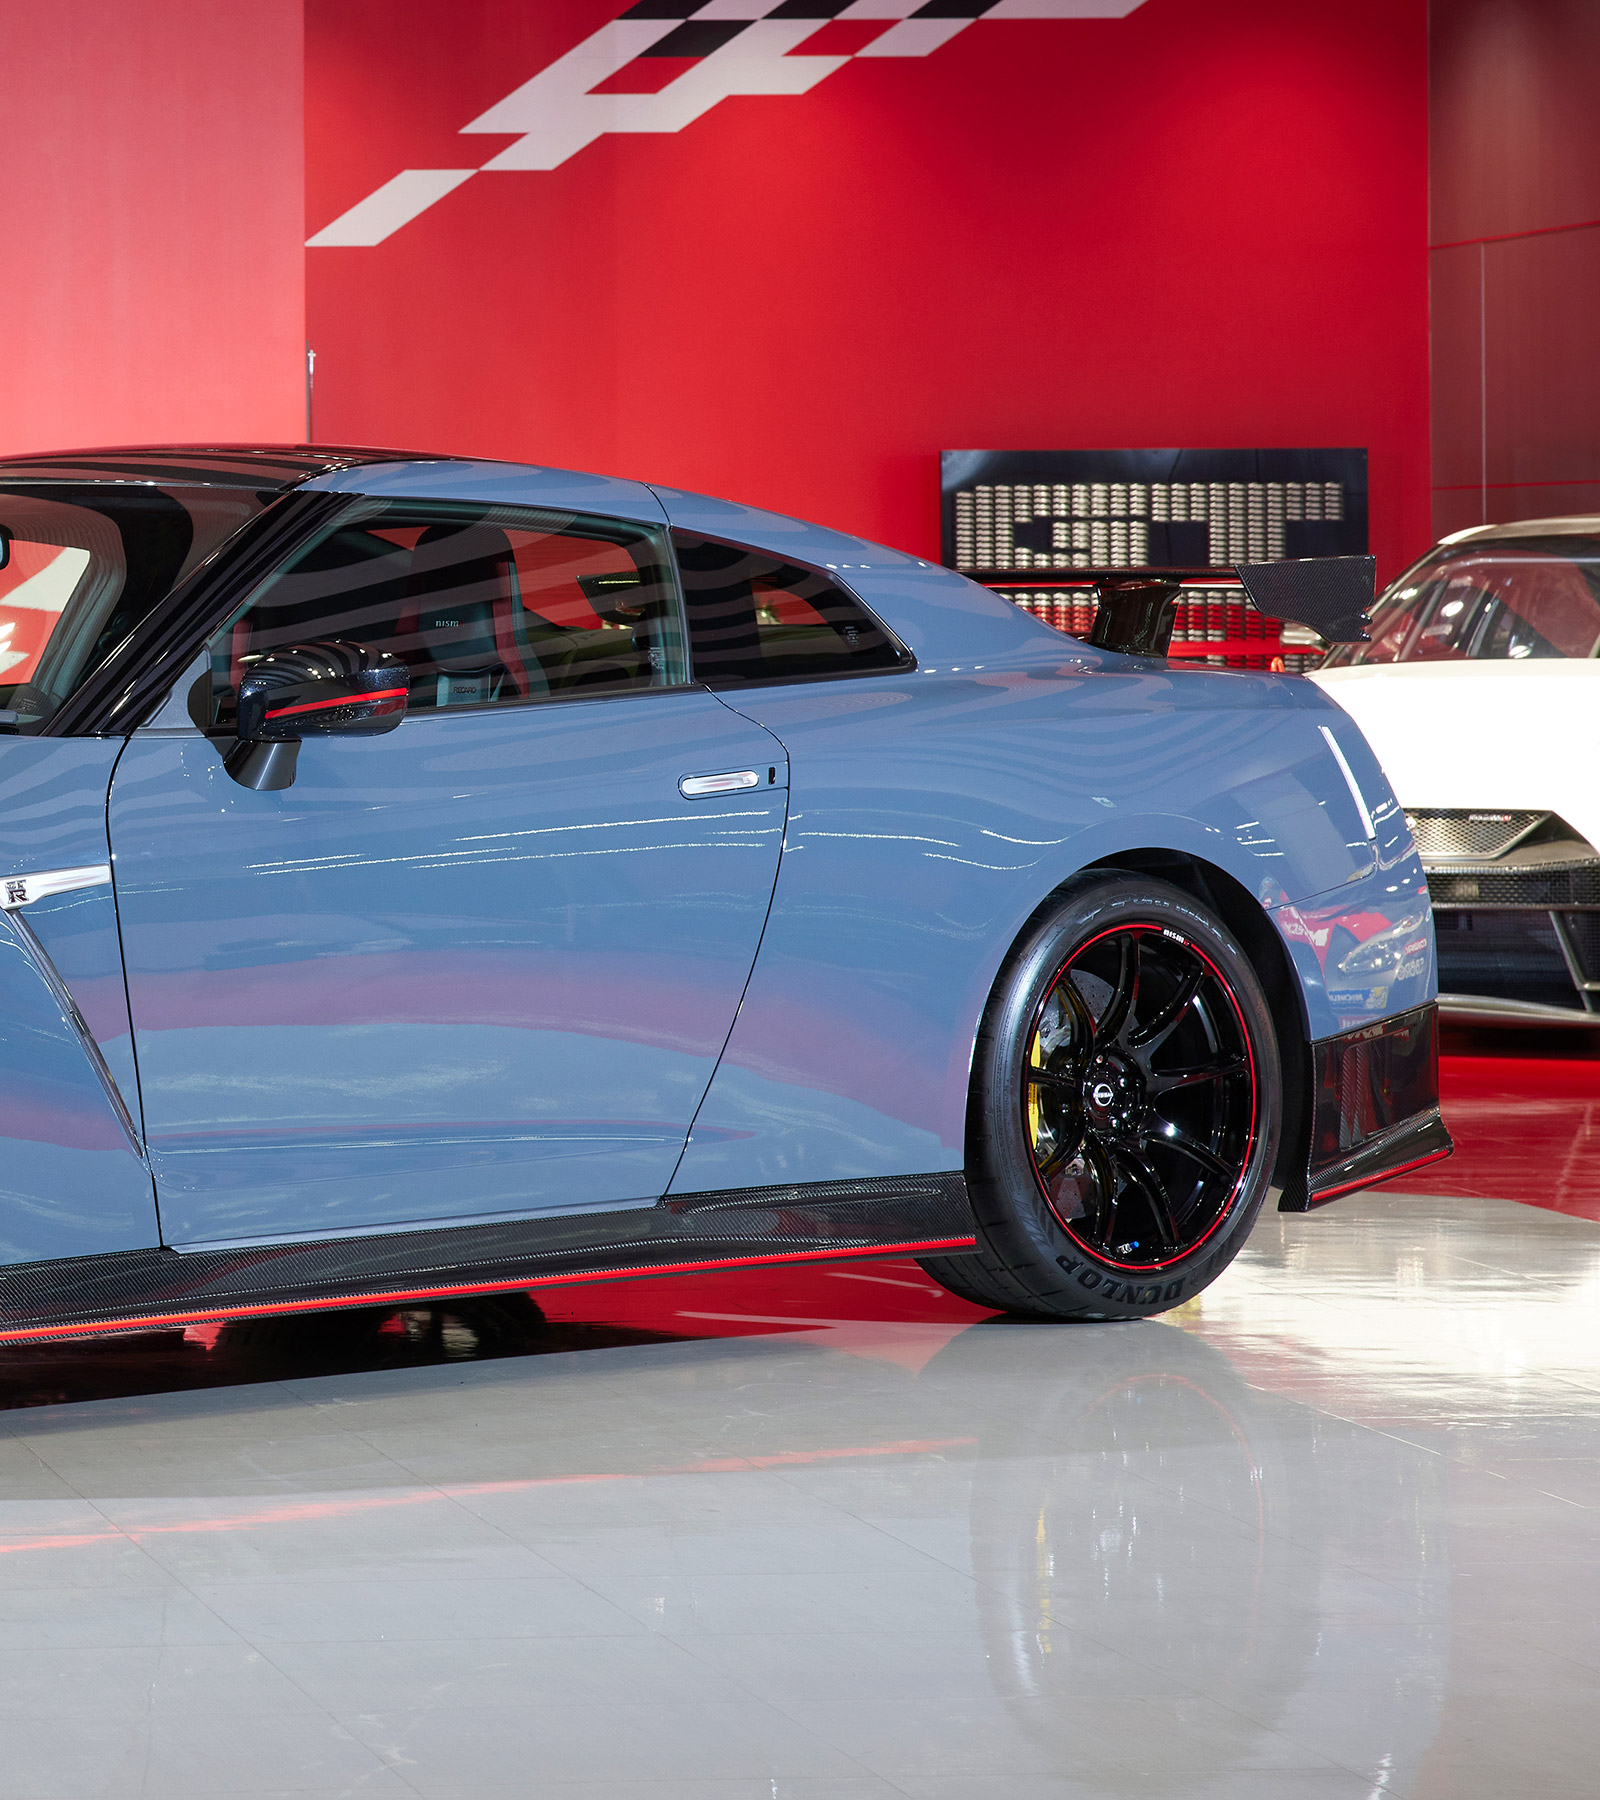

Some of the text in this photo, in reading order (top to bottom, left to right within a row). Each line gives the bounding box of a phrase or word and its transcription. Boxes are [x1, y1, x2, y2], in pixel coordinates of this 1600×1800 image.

[453, 686, 477, 695] RECARO
[1163, 929, 1190, 947] nismo
[1055, 1254, 1185, 1305] DUNLOP
